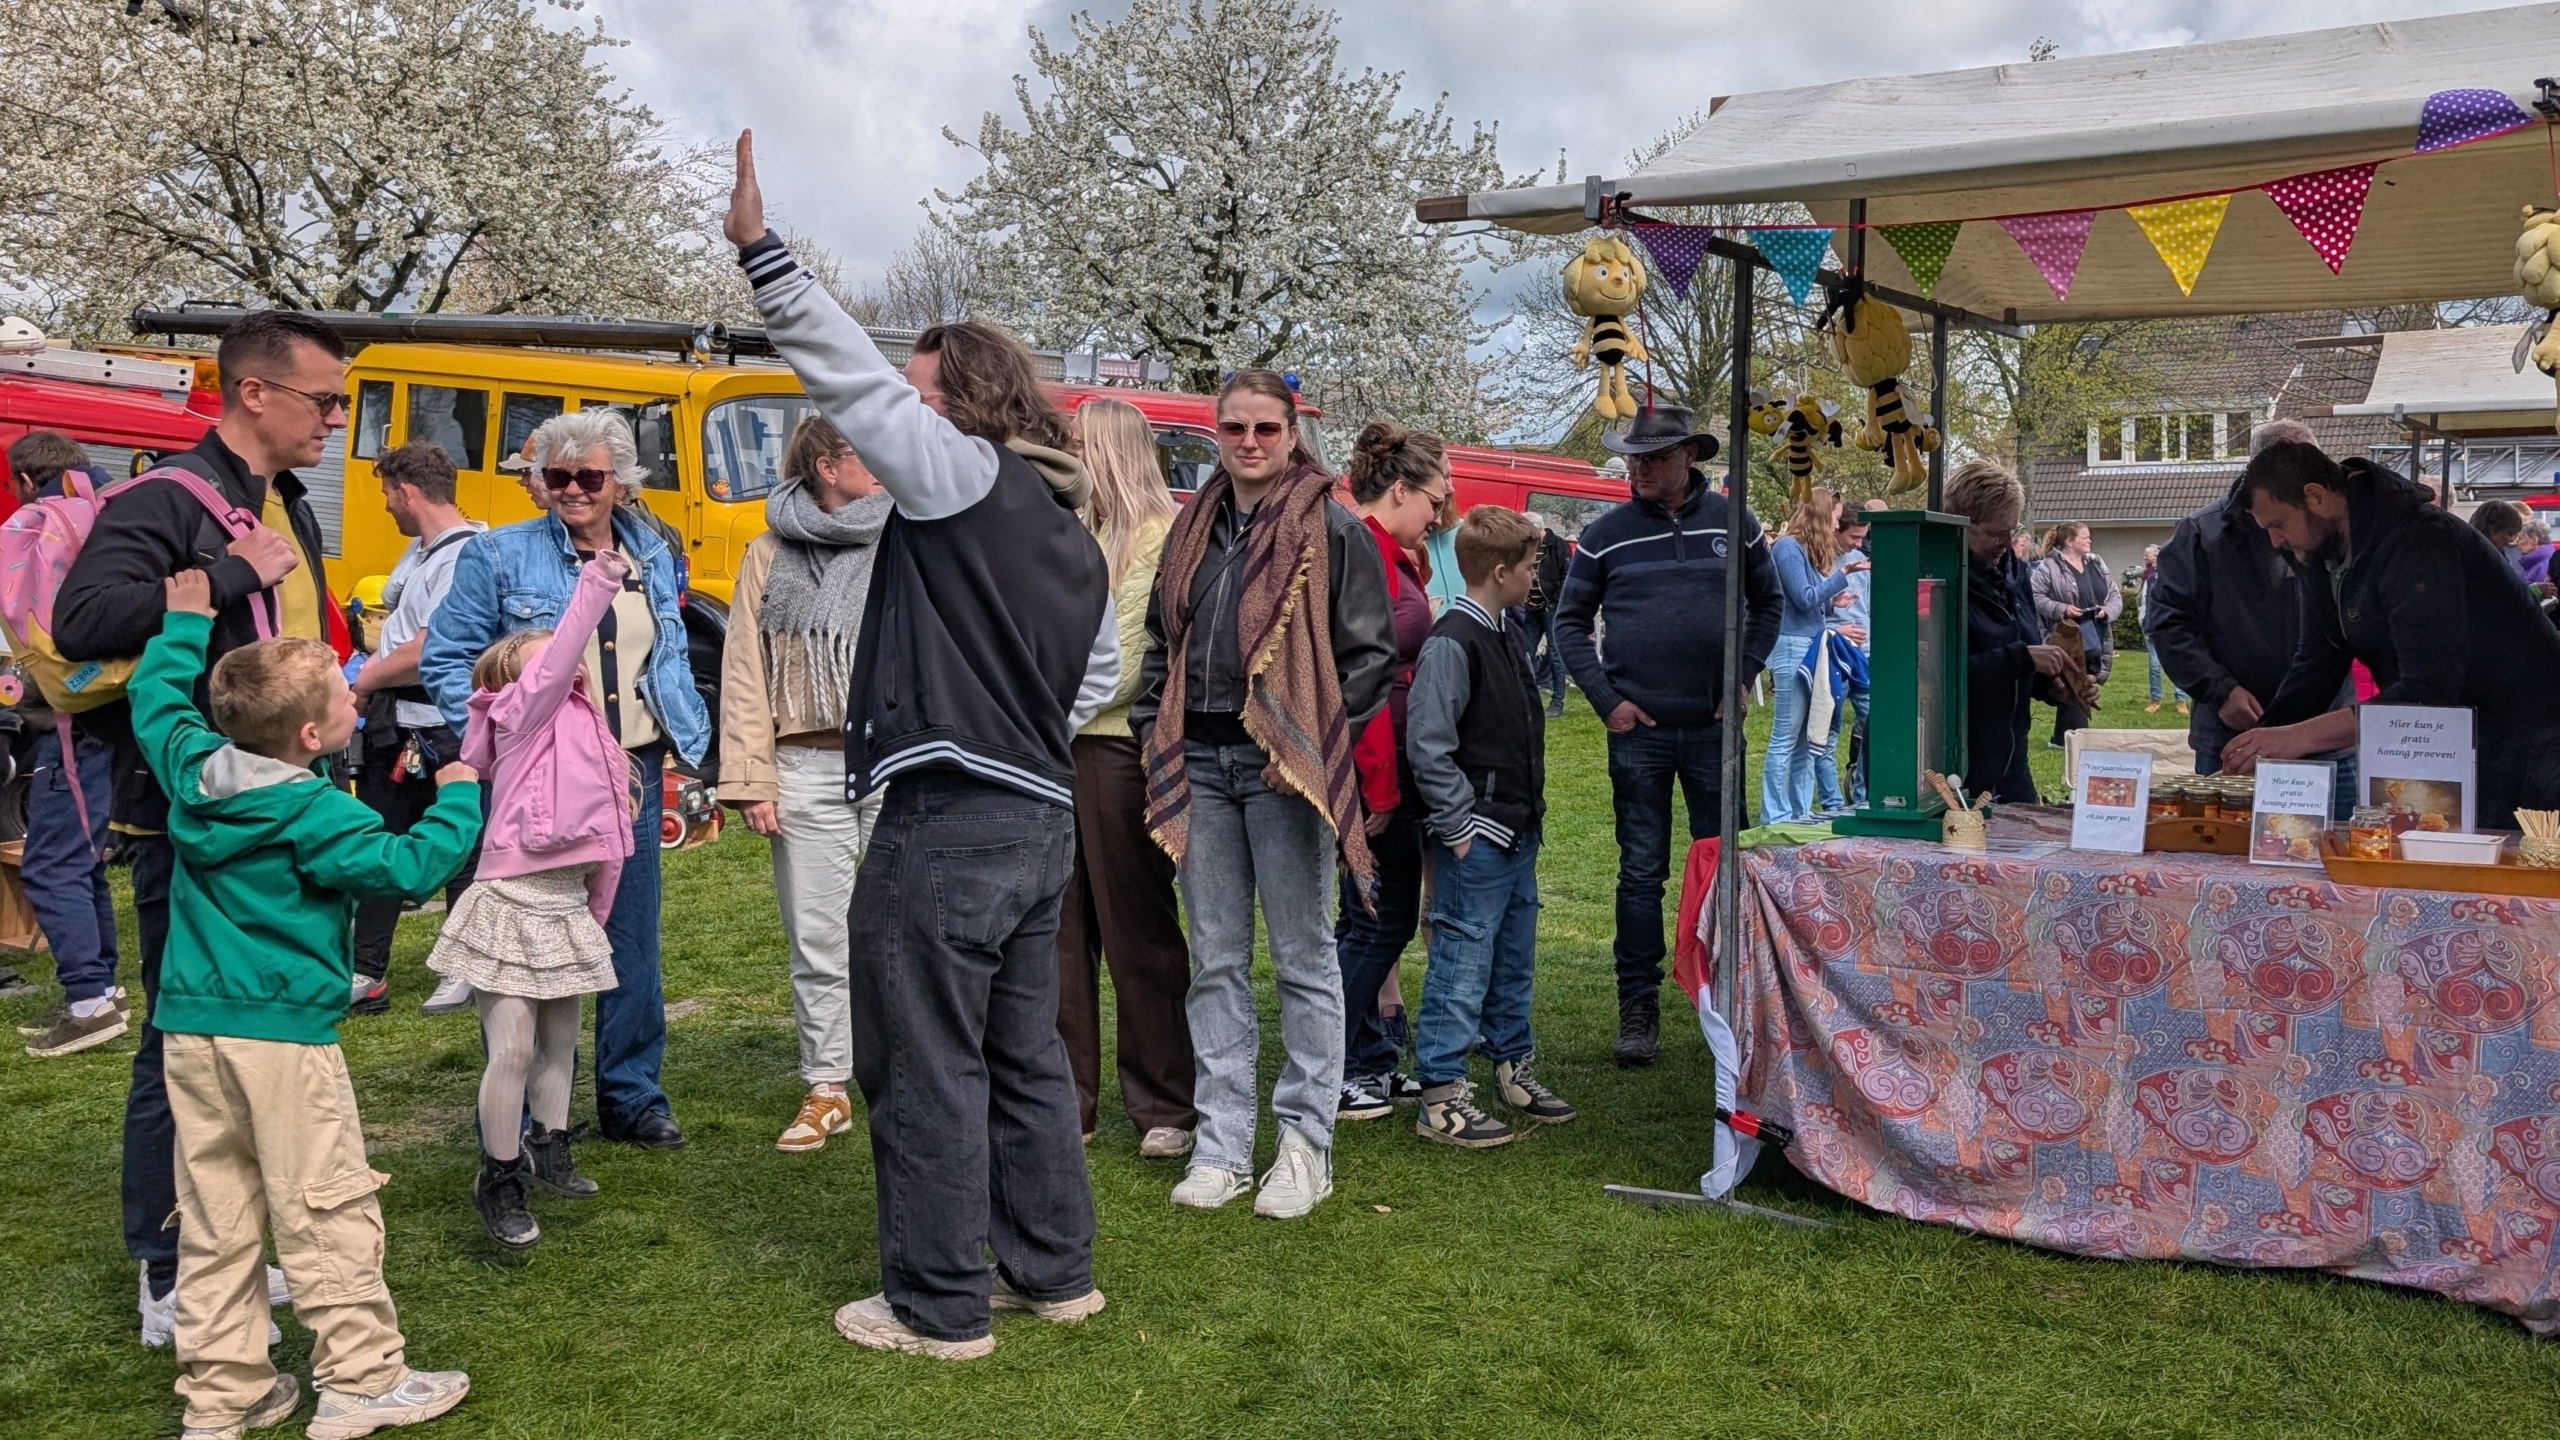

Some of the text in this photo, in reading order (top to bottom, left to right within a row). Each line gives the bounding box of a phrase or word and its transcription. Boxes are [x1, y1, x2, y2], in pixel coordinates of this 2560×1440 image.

[68, 666, 97, 689] ZEBRA
[2388, 719, 2444, 732] Hier kun je
[2401, 735, 2431, 745] gratis
[2377, 747, 2456, 760] honing proeven!
[2086, 763, 2142, 774] Voorjaarshoning
[2291, 778, 2305, 786] kun
[2261, 799, 2287, 808] honing
